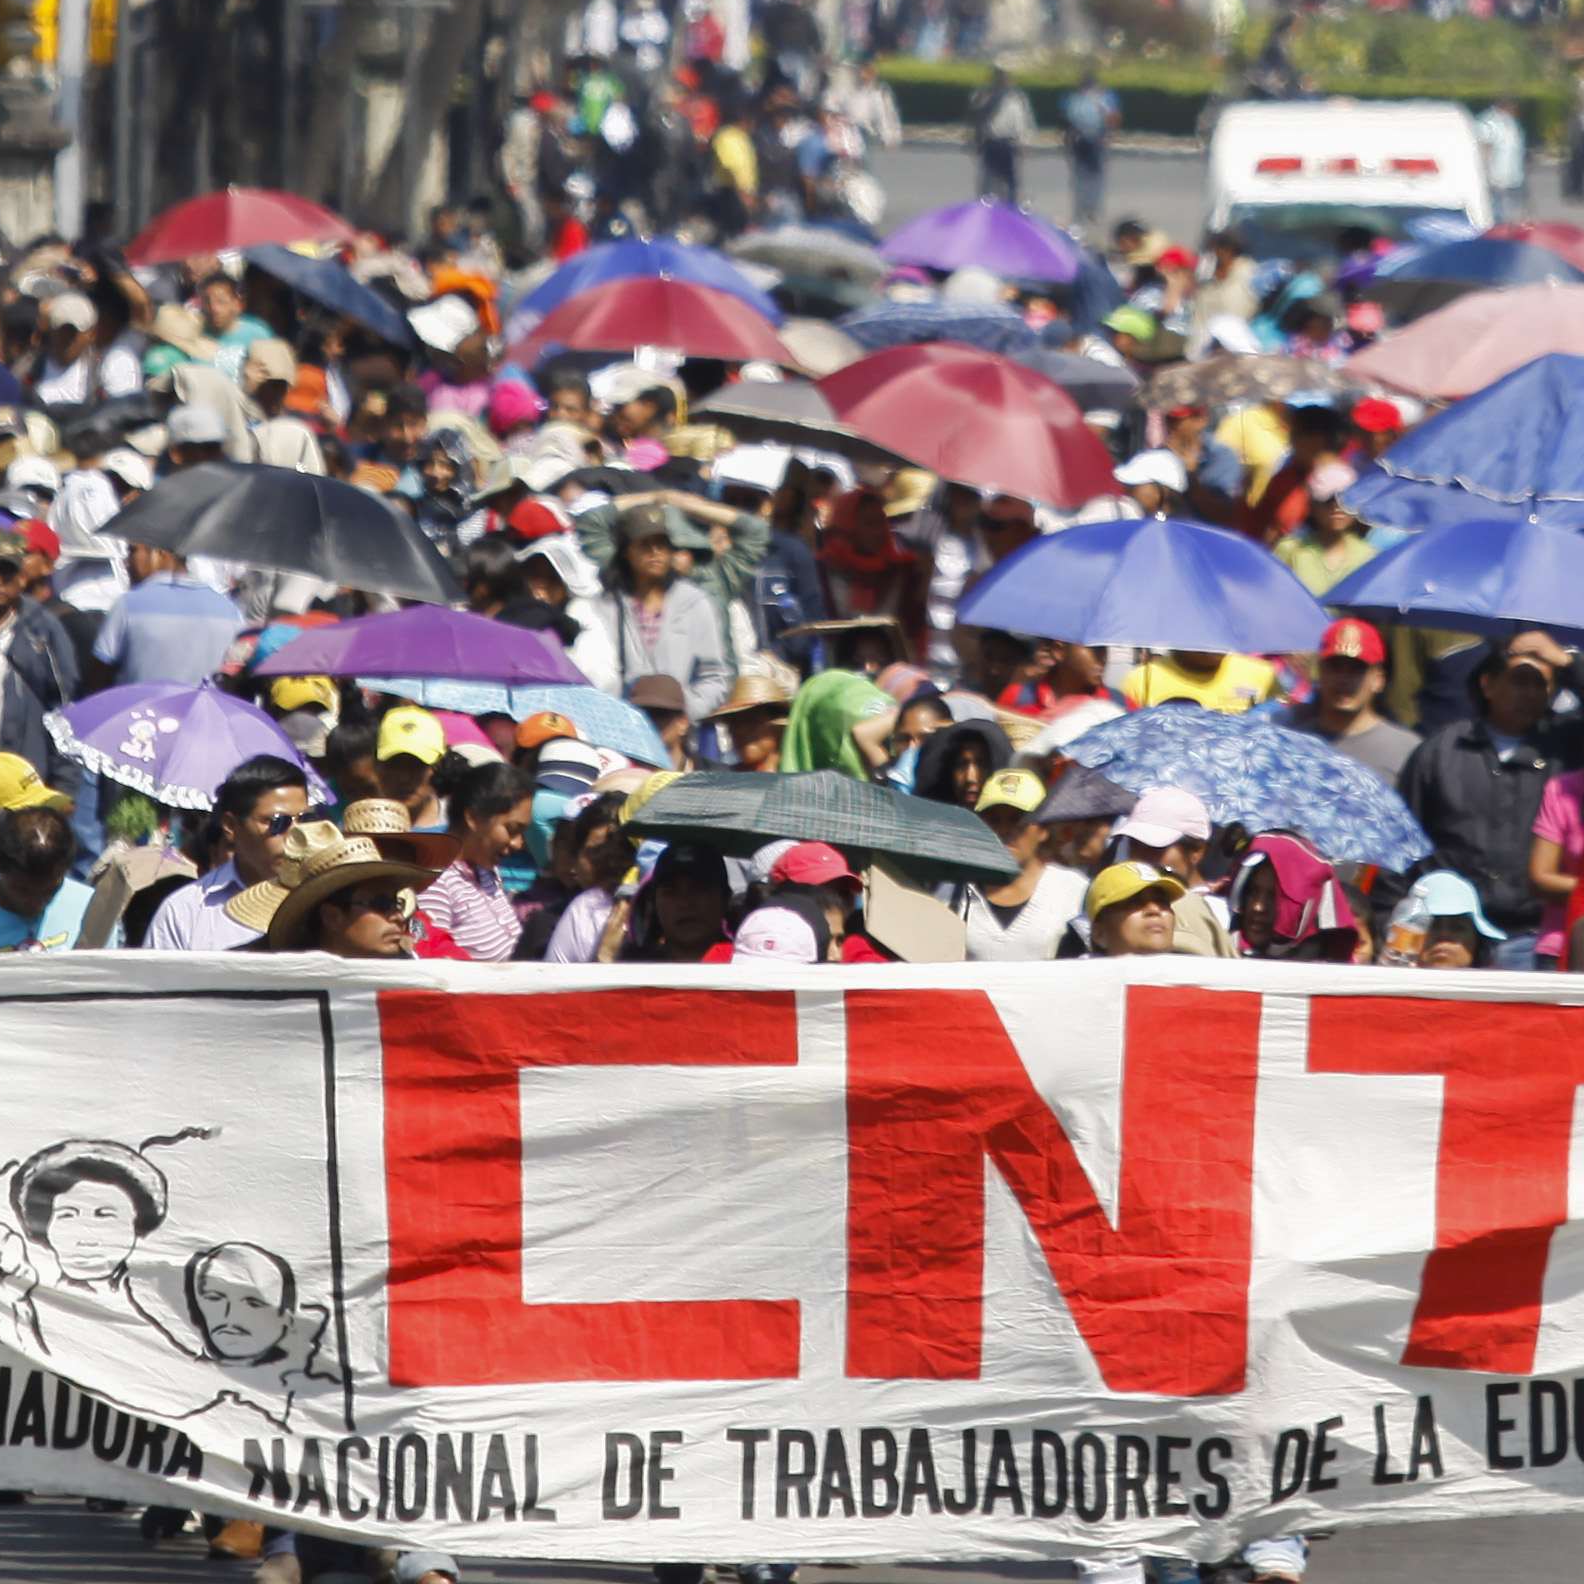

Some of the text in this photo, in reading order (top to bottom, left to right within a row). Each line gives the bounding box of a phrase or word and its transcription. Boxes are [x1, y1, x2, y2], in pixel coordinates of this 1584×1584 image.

[243, 1432, 556, 1523] NACIONAL
[602, 1430, 683, 1520] DE
[727, 1427, 1235, 1524] TRABAJADORES
[1270, 1416, 1344, 1506] DE
[1371, 1394, 1444, 1487] LA
